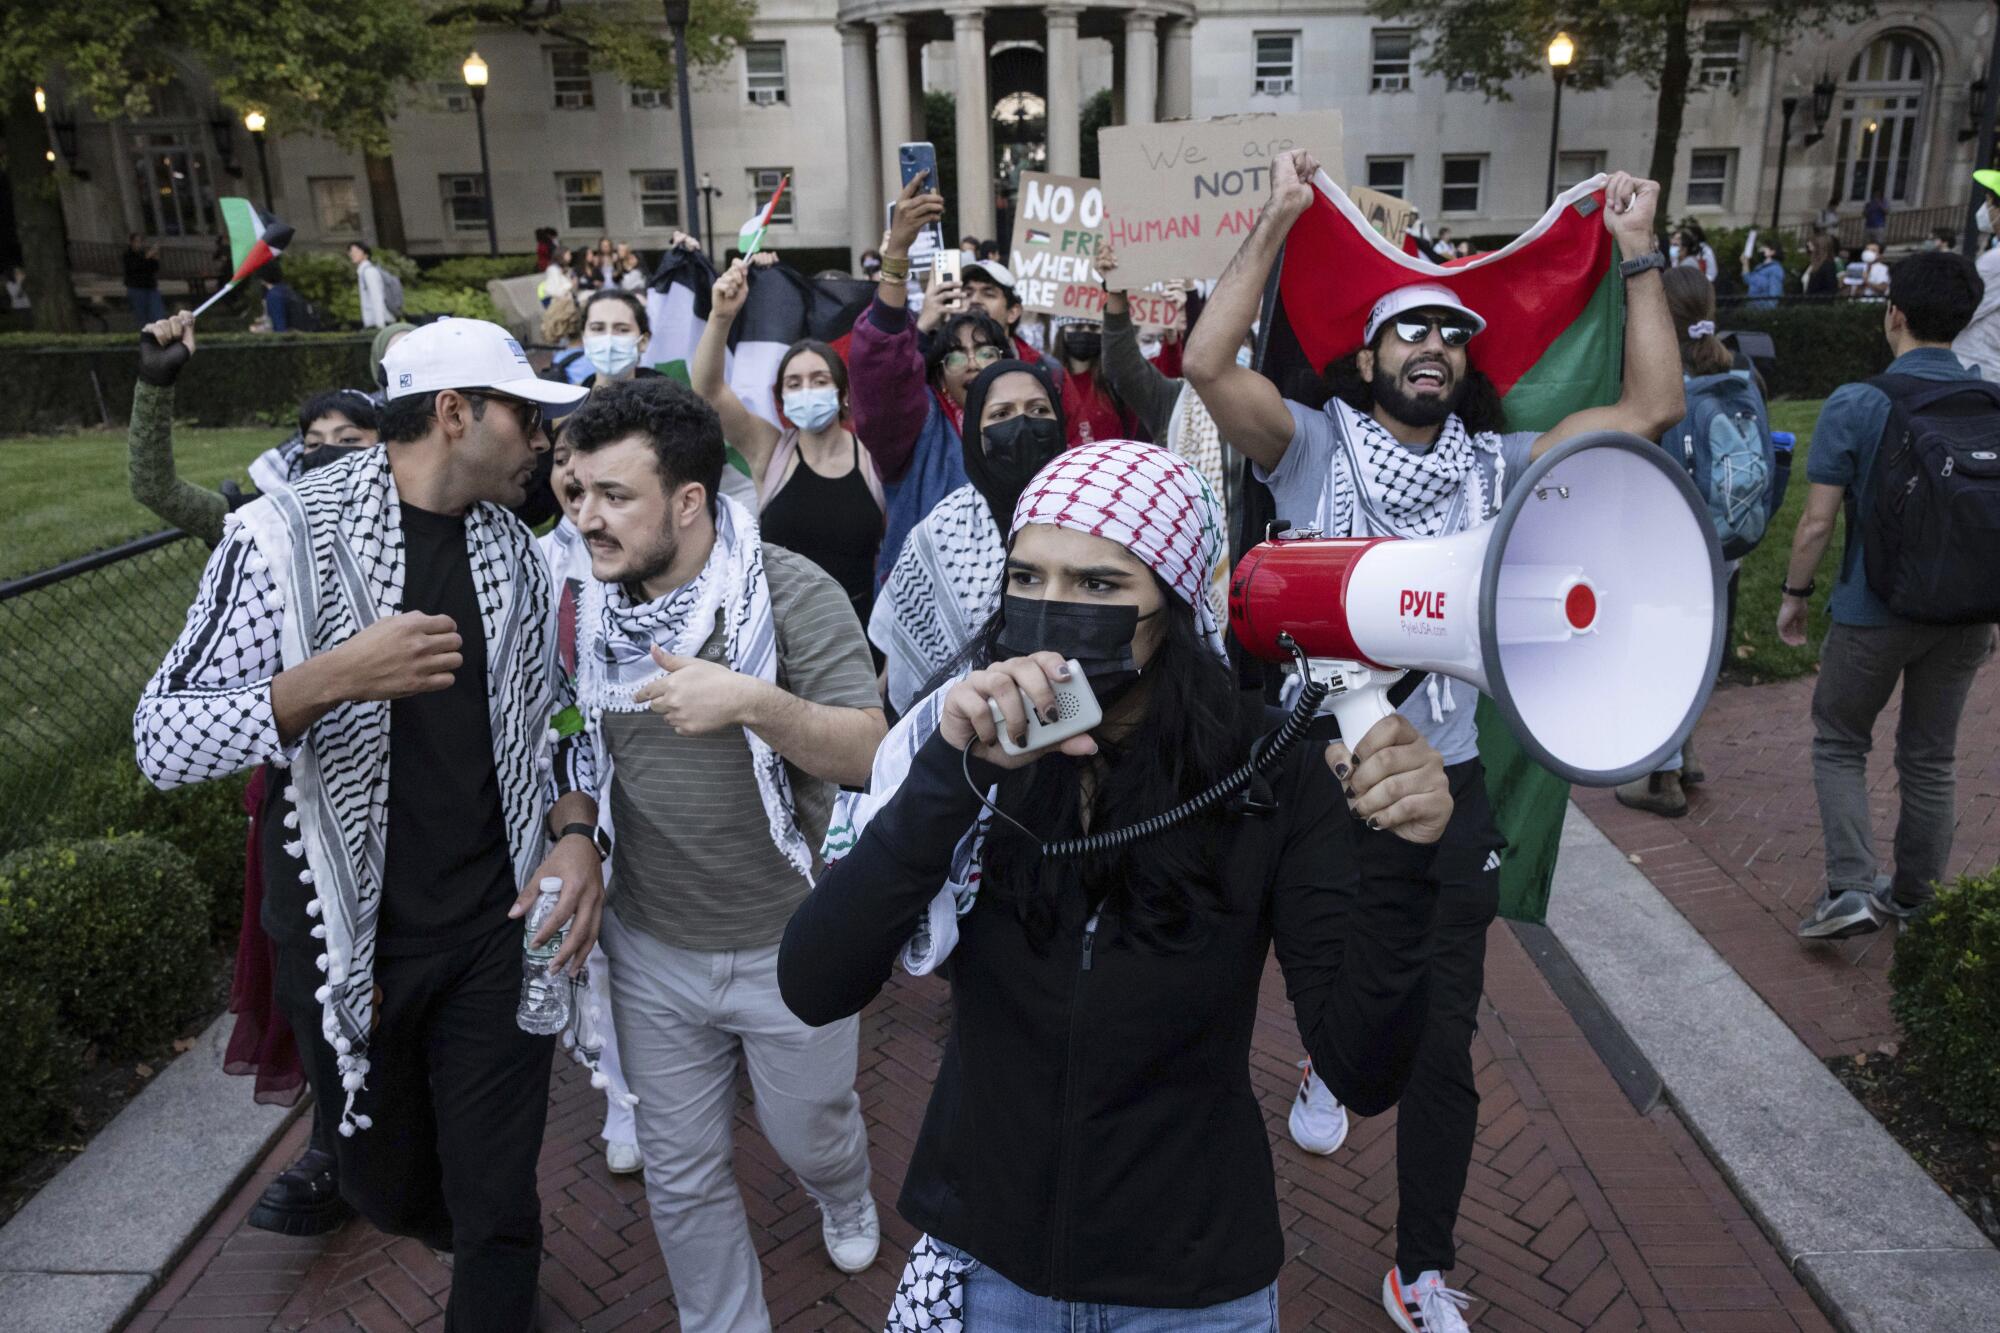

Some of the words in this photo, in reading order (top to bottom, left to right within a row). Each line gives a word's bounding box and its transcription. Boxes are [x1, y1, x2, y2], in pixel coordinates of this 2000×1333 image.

[1141, 135, 1208, 171] We
[1243, 138, 1295, 158] are
[1194, 166, 1269, 200] NOT
[1023, 180, 1075, 225] NO
[1215, 208, 1265, 237] AN
[1061, 229, 1104, 257] FRE
[1012, 249, 1090, 283] WHEN
[1012, 278, 1059, 308] ARE
[1400, 590, 1445, 619] PYLE
